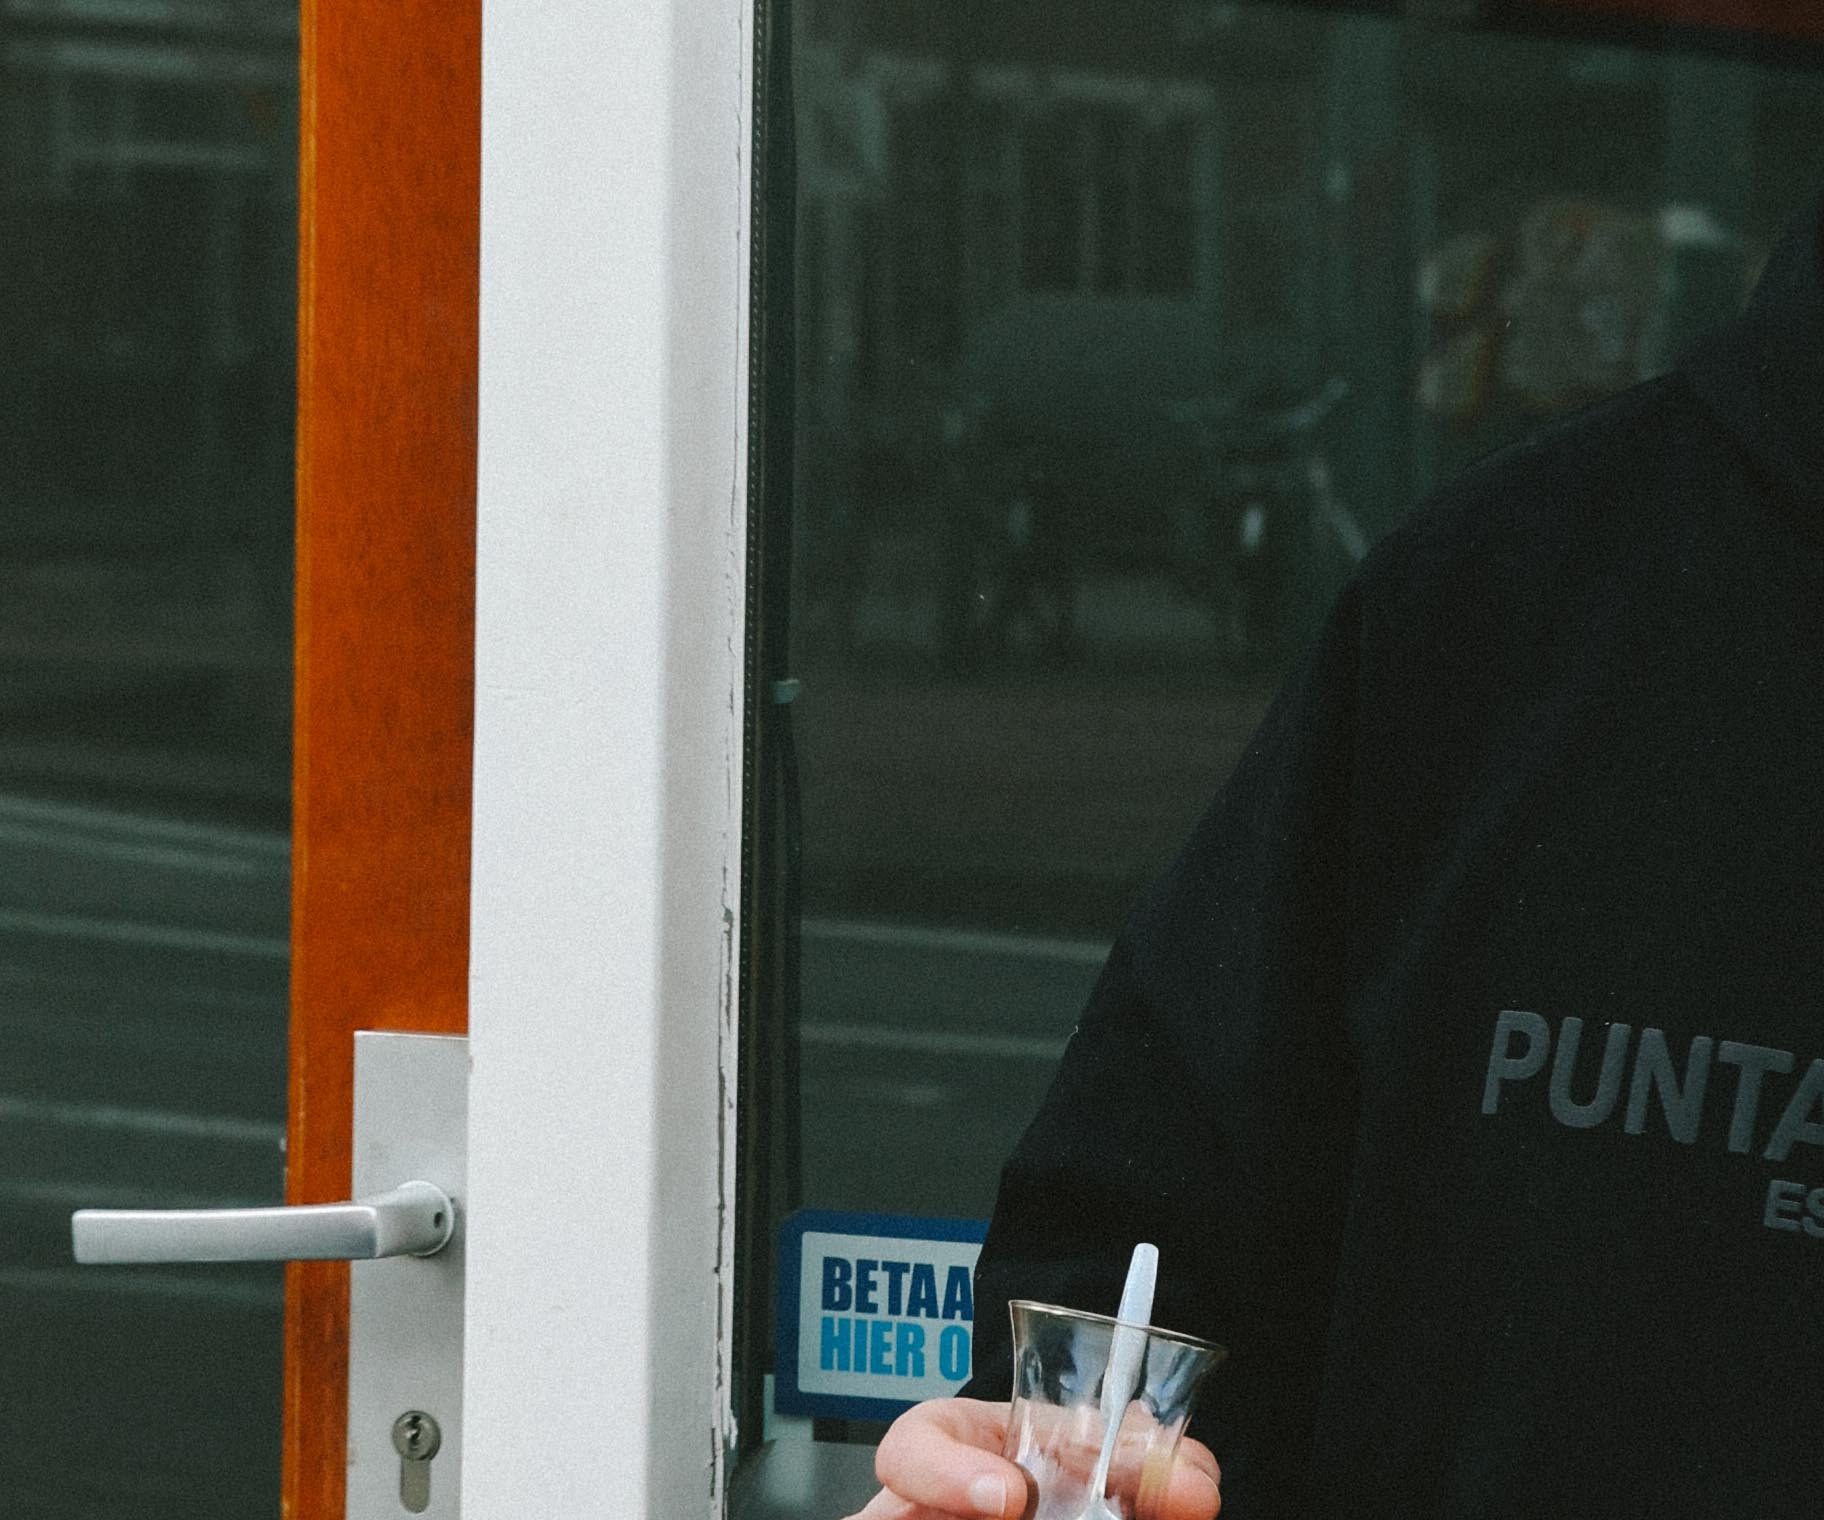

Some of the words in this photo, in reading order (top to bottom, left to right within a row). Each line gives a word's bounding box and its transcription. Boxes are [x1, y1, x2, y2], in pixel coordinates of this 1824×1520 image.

[822, 1256, 973, 1321] BETAA
[820, 1316, 925, 1377] HIER
[939, 1325, 971, 1381] O
